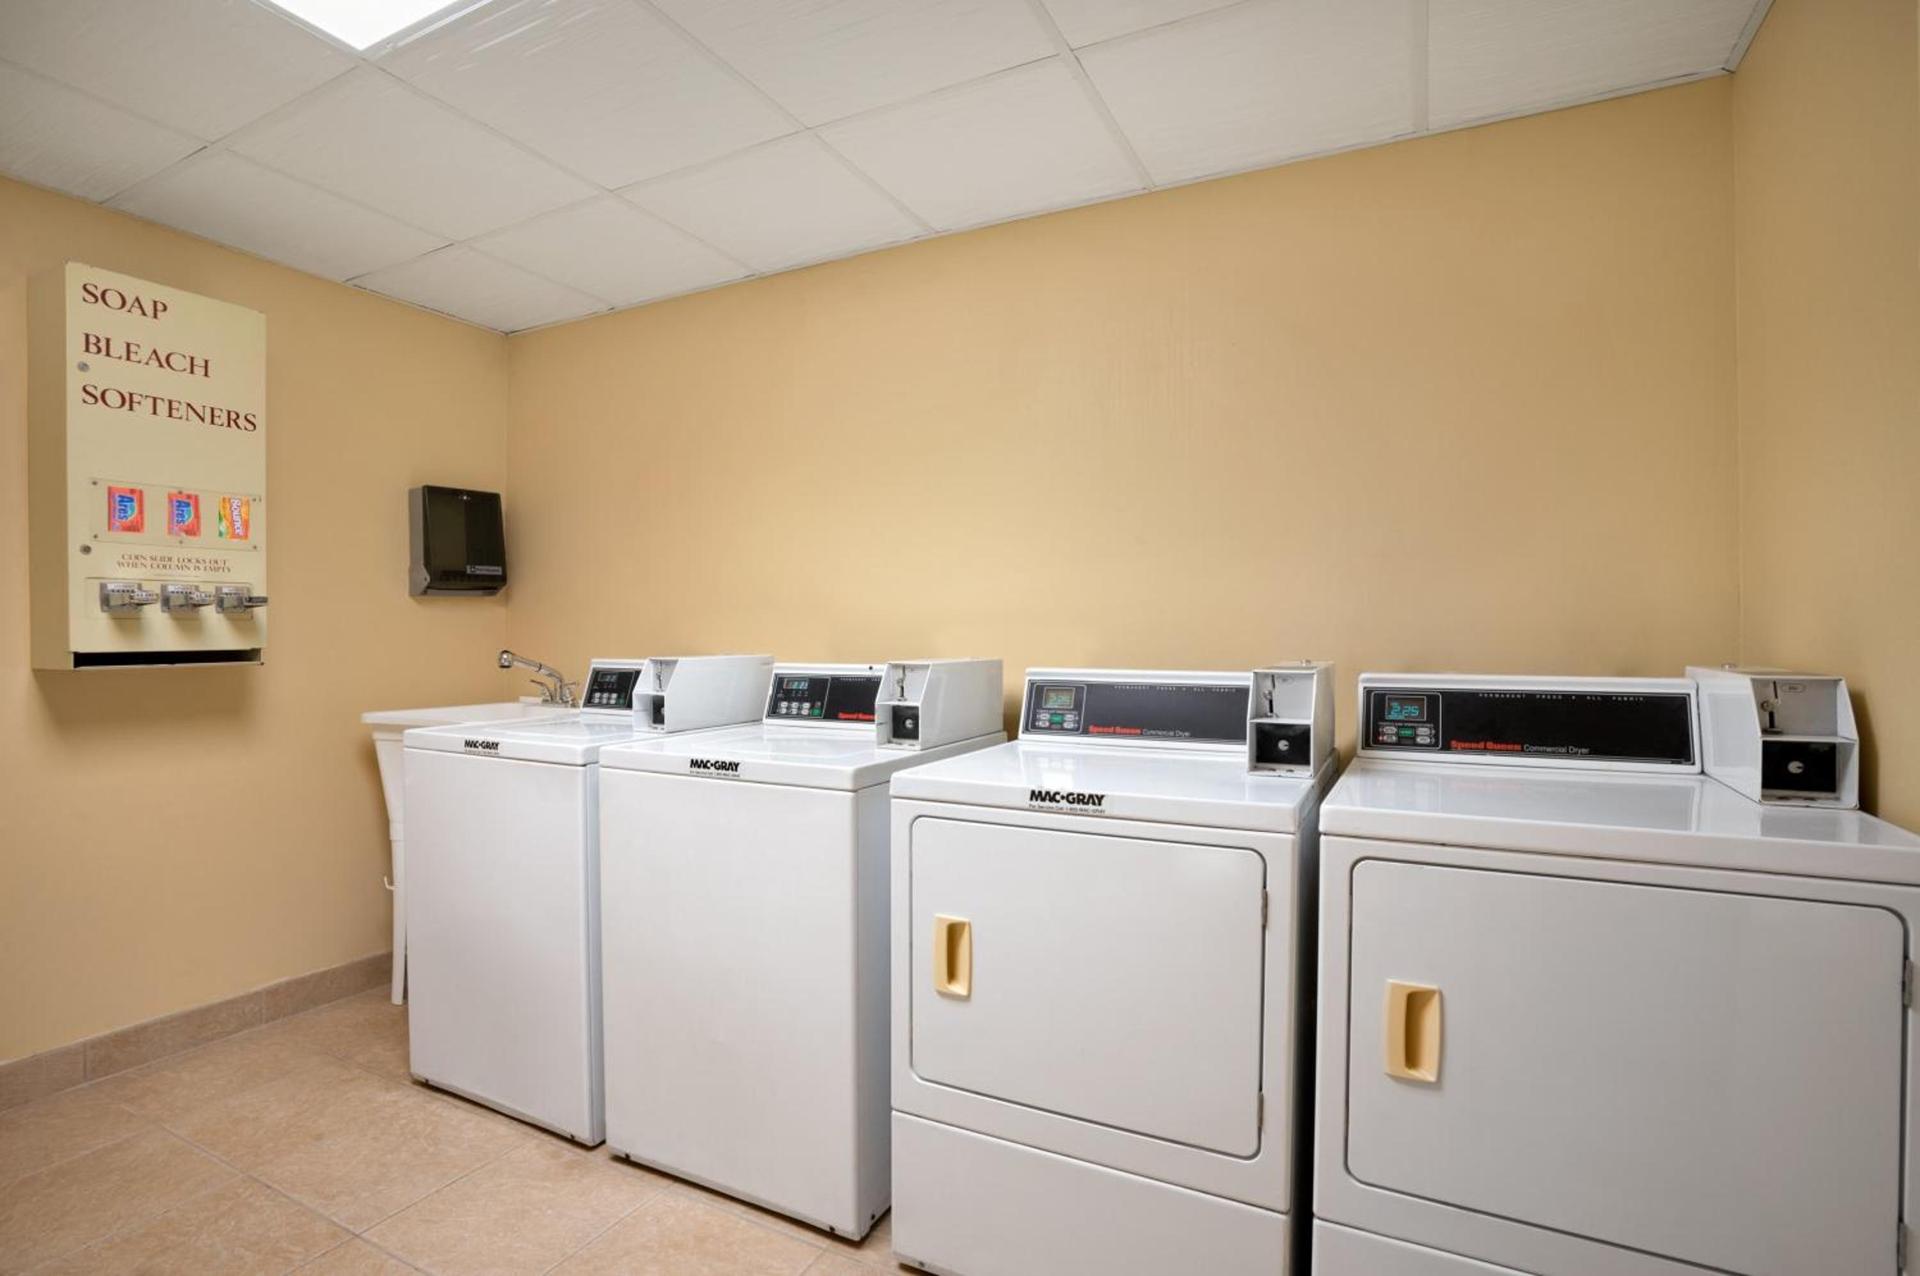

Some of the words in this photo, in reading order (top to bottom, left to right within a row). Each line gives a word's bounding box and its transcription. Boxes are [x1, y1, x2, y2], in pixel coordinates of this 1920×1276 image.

[82, 283, 168, 320] SOAP
[83, 332, 211, 378] BLEACH
[82, 384, 257, 432] SOFTENERS
[1089, 724, 1114, 735] Speed
[1450, 740, 1485, 751] Speed
[1486, 741, 1522, 752] Queen
[1523, 744, 1568, 753] Commercial
[1568, 746, 1590, 755] Dryer
